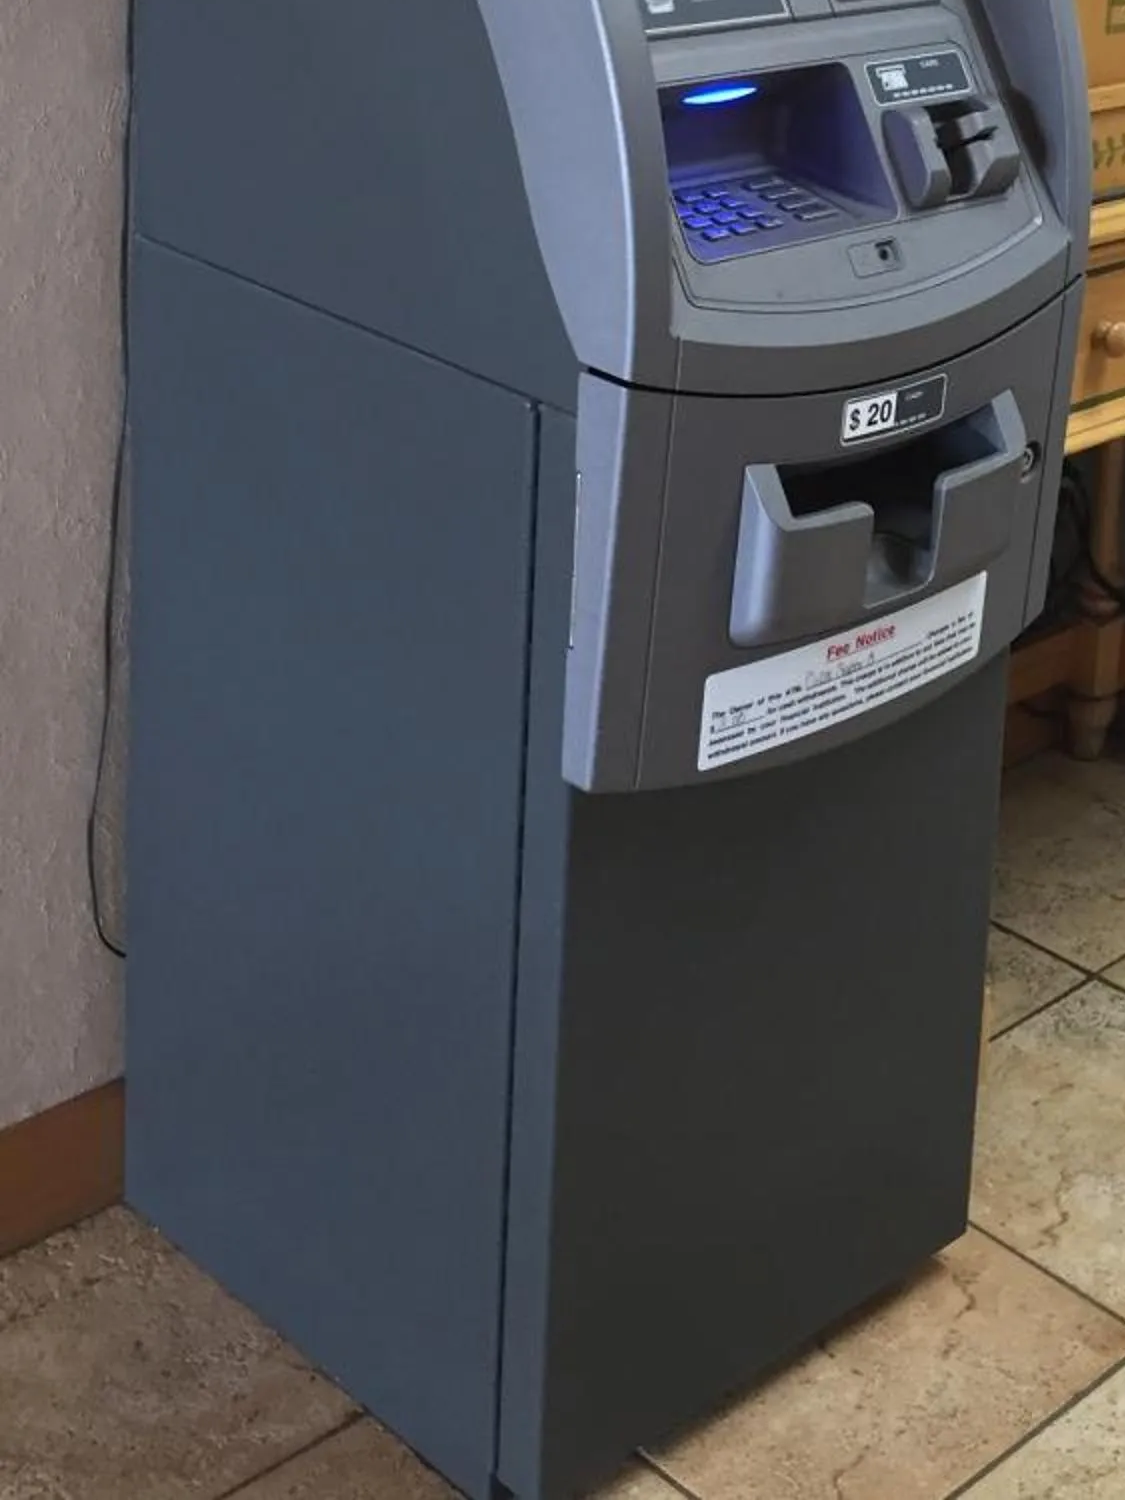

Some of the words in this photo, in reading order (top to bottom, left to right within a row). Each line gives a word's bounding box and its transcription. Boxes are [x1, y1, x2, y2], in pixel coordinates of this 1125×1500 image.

[866, 399, 893, 427] 20
[826, 643, 850, 661] Fee
[855, 624, 896, 649] Notice
